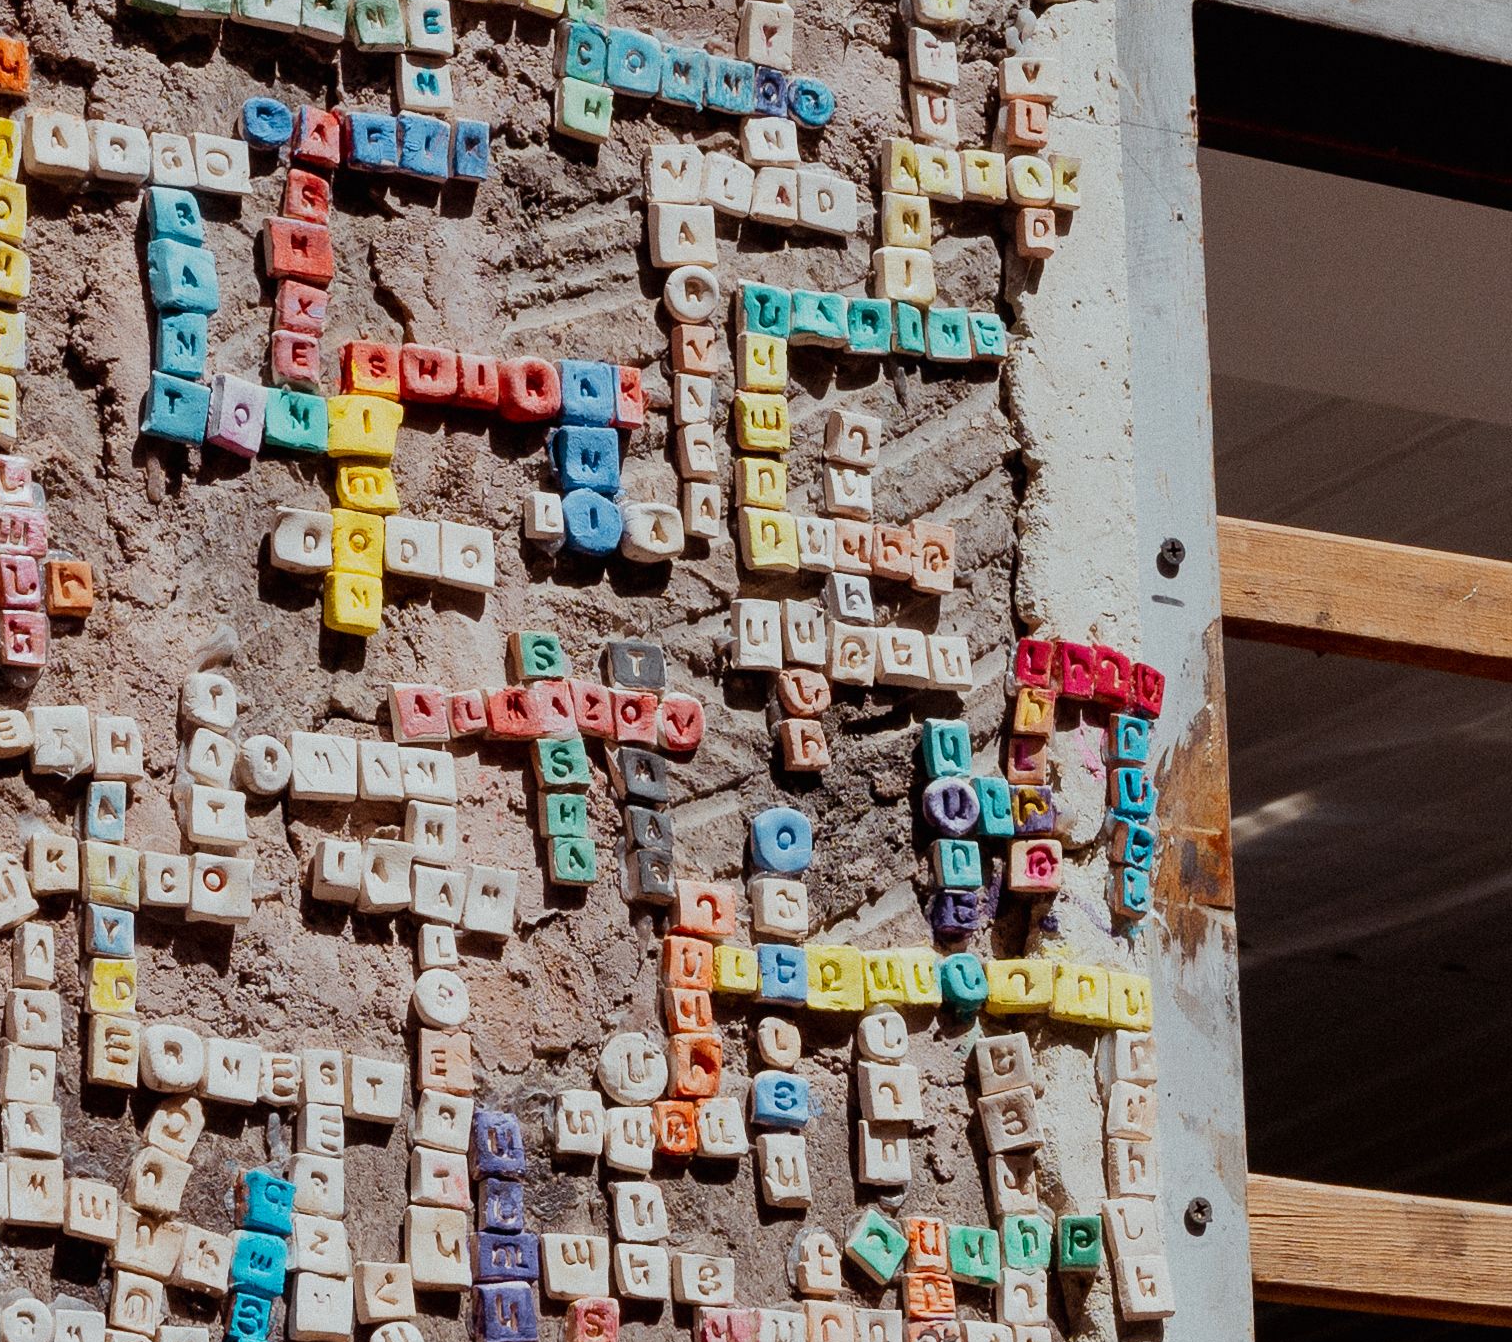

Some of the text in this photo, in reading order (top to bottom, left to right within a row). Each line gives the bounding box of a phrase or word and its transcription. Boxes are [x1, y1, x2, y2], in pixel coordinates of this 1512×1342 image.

[657, 150, 845, 219] VLAD
[402, 685, 702, 742] ALMAZOV
[526, 634, 596, 877] SASHA
